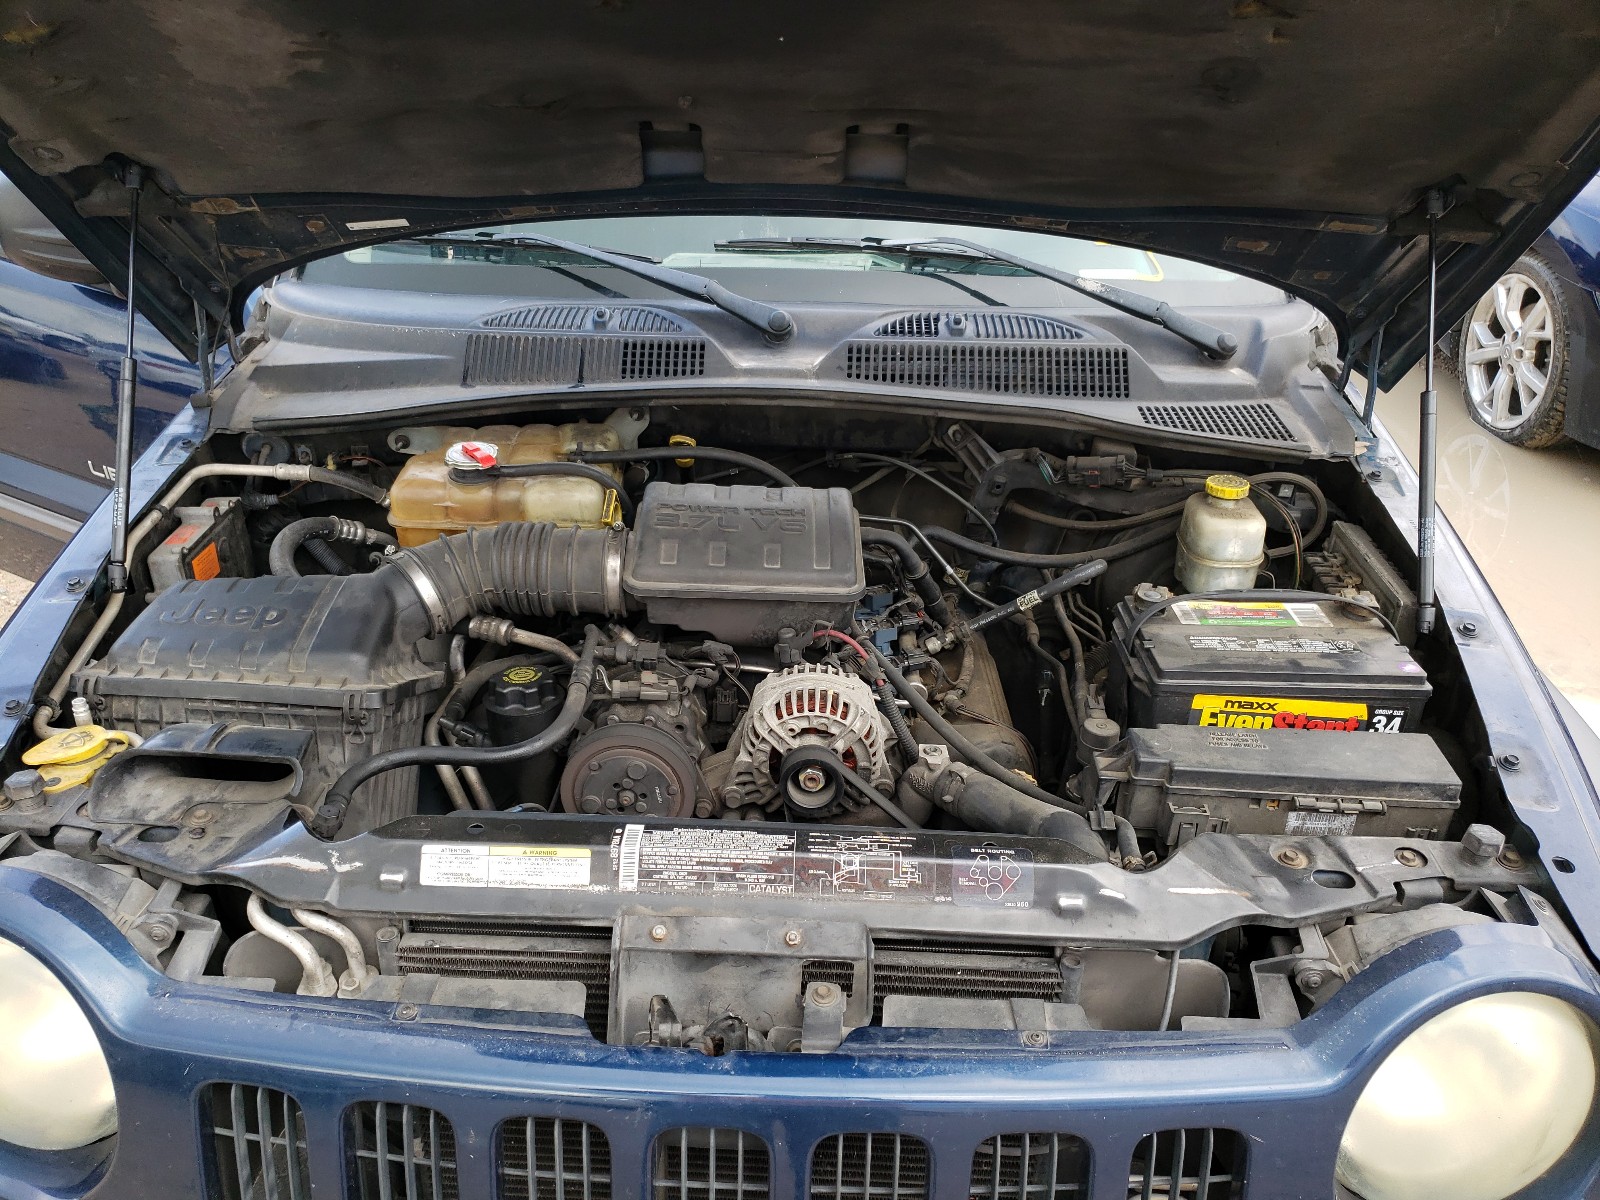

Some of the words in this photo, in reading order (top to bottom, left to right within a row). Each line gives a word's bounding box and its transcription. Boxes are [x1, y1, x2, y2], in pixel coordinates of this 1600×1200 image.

[116, 487, 124, 526] STABILUS
[657, 503, 740, 514] POWER
[744, 507, 807, 517] TECH
[654, 513, 740, 533] 3.7L
[750, 517, 808, 535] V6
[1019, 595, 1039, 607] FUEL
[159, 600, 288, 632] Jeep
[1224, 699, 1280, 712] maxx
[1200, 707, 1360, 732] EverStart
[1369, 715, 1402, 734] 34
[749, 884, 793, 895] CATALYST
